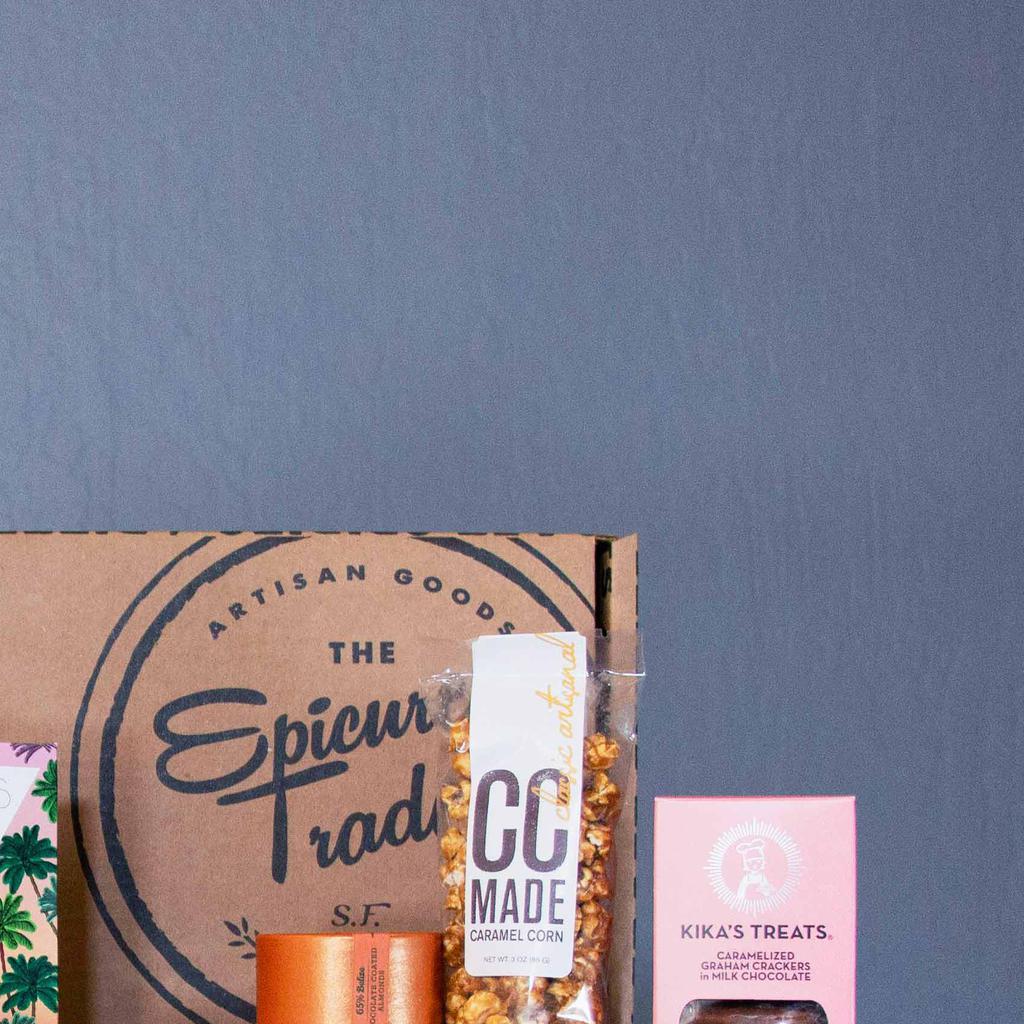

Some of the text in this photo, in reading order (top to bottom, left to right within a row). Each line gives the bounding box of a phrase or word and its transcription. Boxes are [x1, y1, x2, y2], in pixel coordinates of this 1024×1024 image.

[208, 564, 515, 640] ARTISAN GOODS
[329, 641, 396, 665] THE
[153, 686, 434, 884] Epicur
[472, 768, 569, 873] CC
[470, 879, 565, 925] MADE
[331, 902, 392, 927] S.F.
[470, 929, 564, 943] CARAMEL CORN
[681, 924, 744, 939] KIKA'S
[701, 962, 811, 971] GRAHAM CRACKERS
[717, 951, 795, 960] CARAMELIZED
[700, 972, 811, 980] in MILK CHOCOLATE
[356, 994, 365, 1015] 65%
